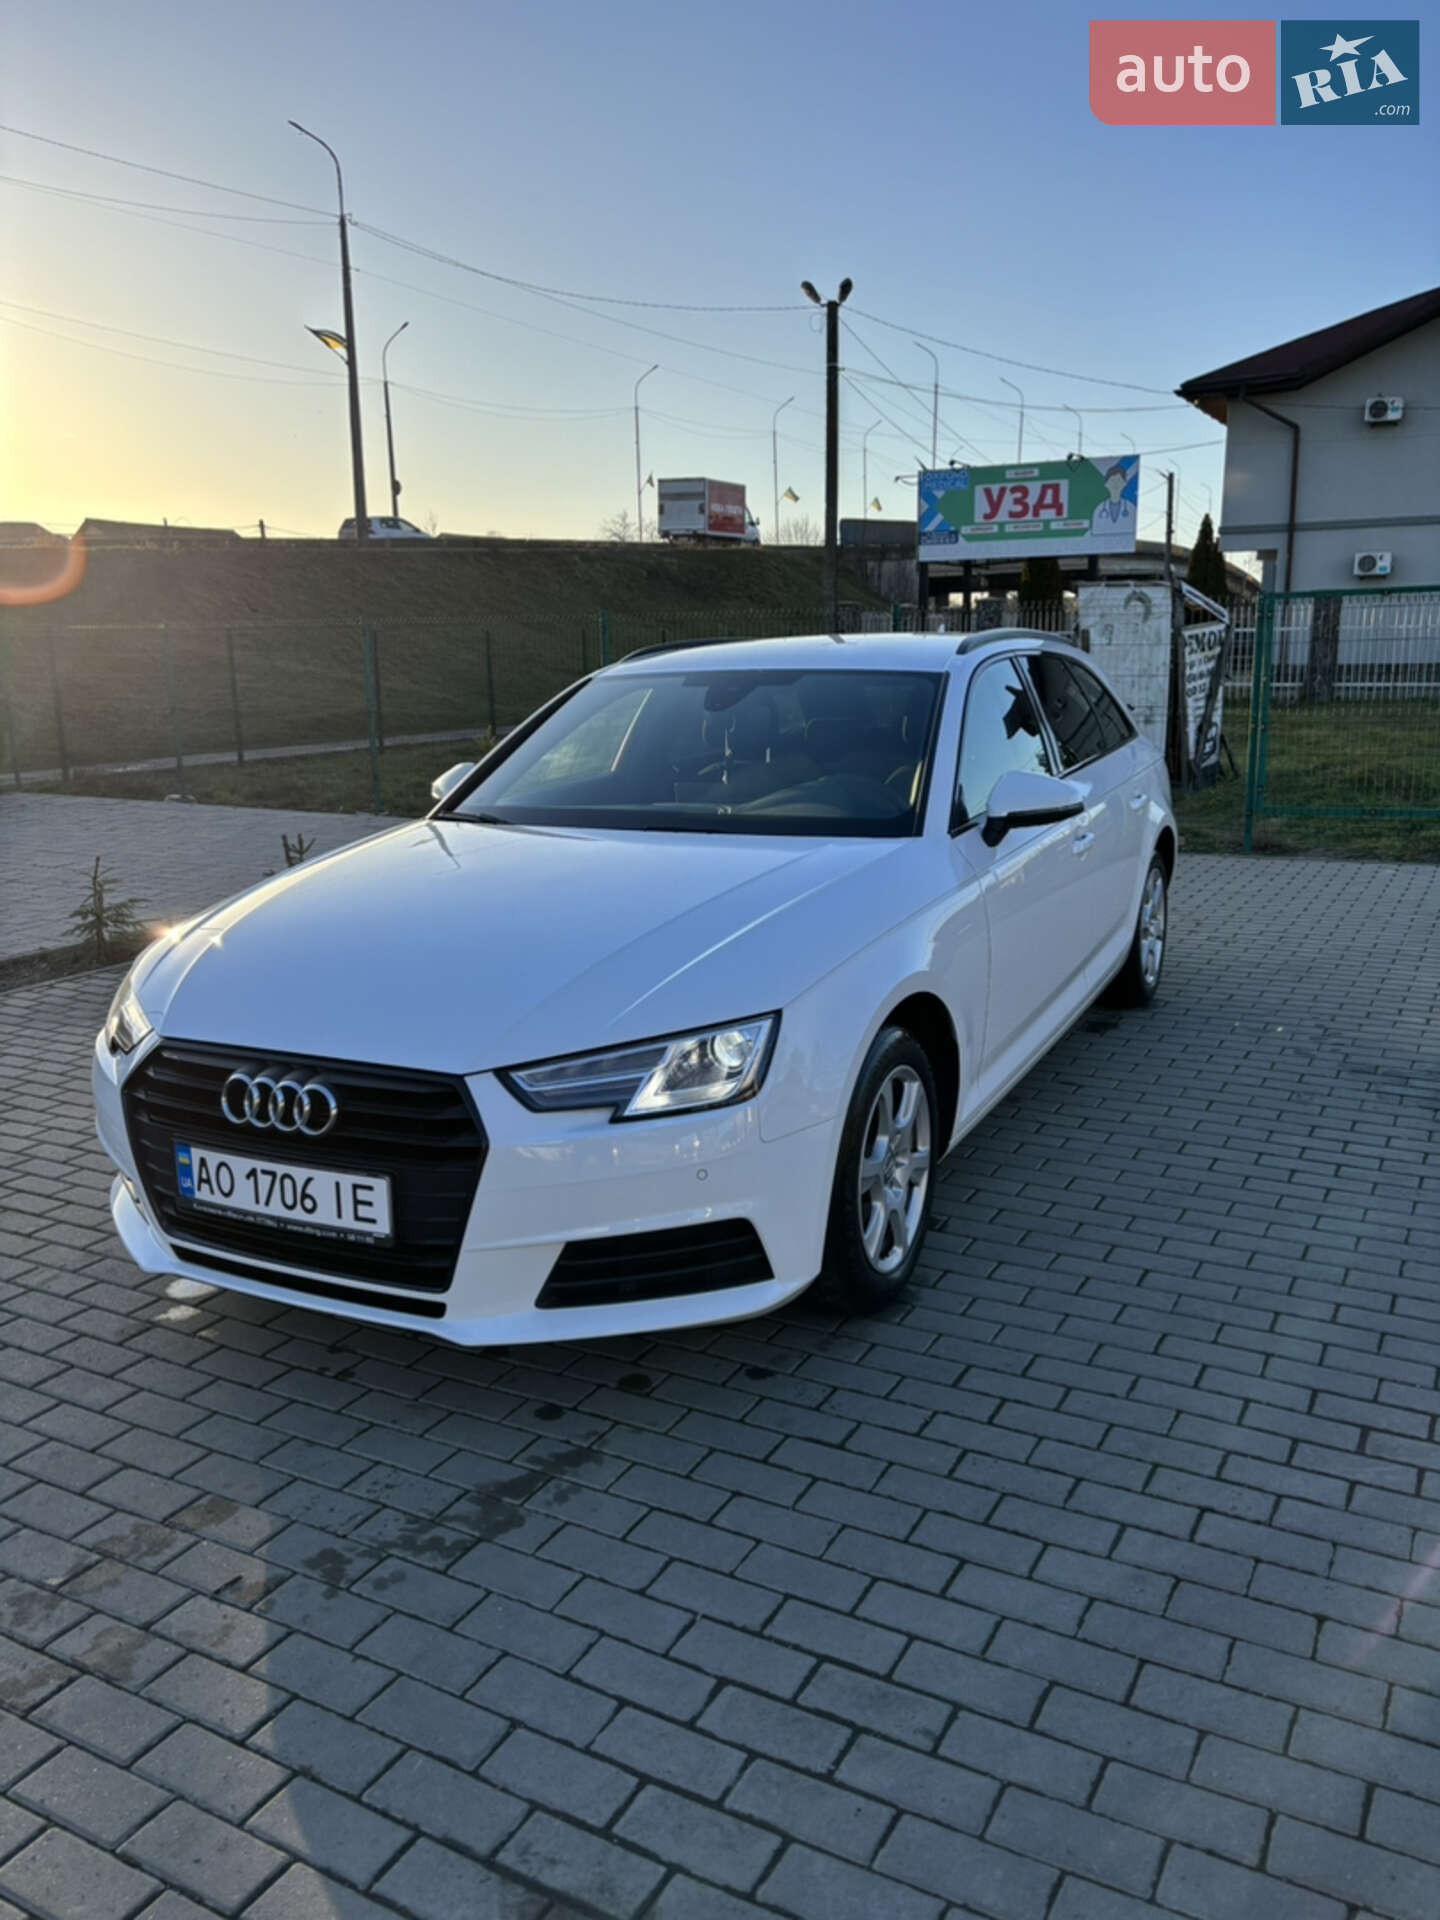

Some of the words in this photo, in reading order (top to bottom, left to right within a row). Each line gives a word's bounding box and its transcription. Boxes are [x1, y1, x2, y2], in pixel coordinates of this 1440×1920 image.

[982, 483, 1064, 521] УЗД
[182, 1178, 193, 1188] UA
[197, 1156, 235, 1198] AO
[245, 1167, 318, 1215] 1706
[335, 1181, 377, 1225] IE
